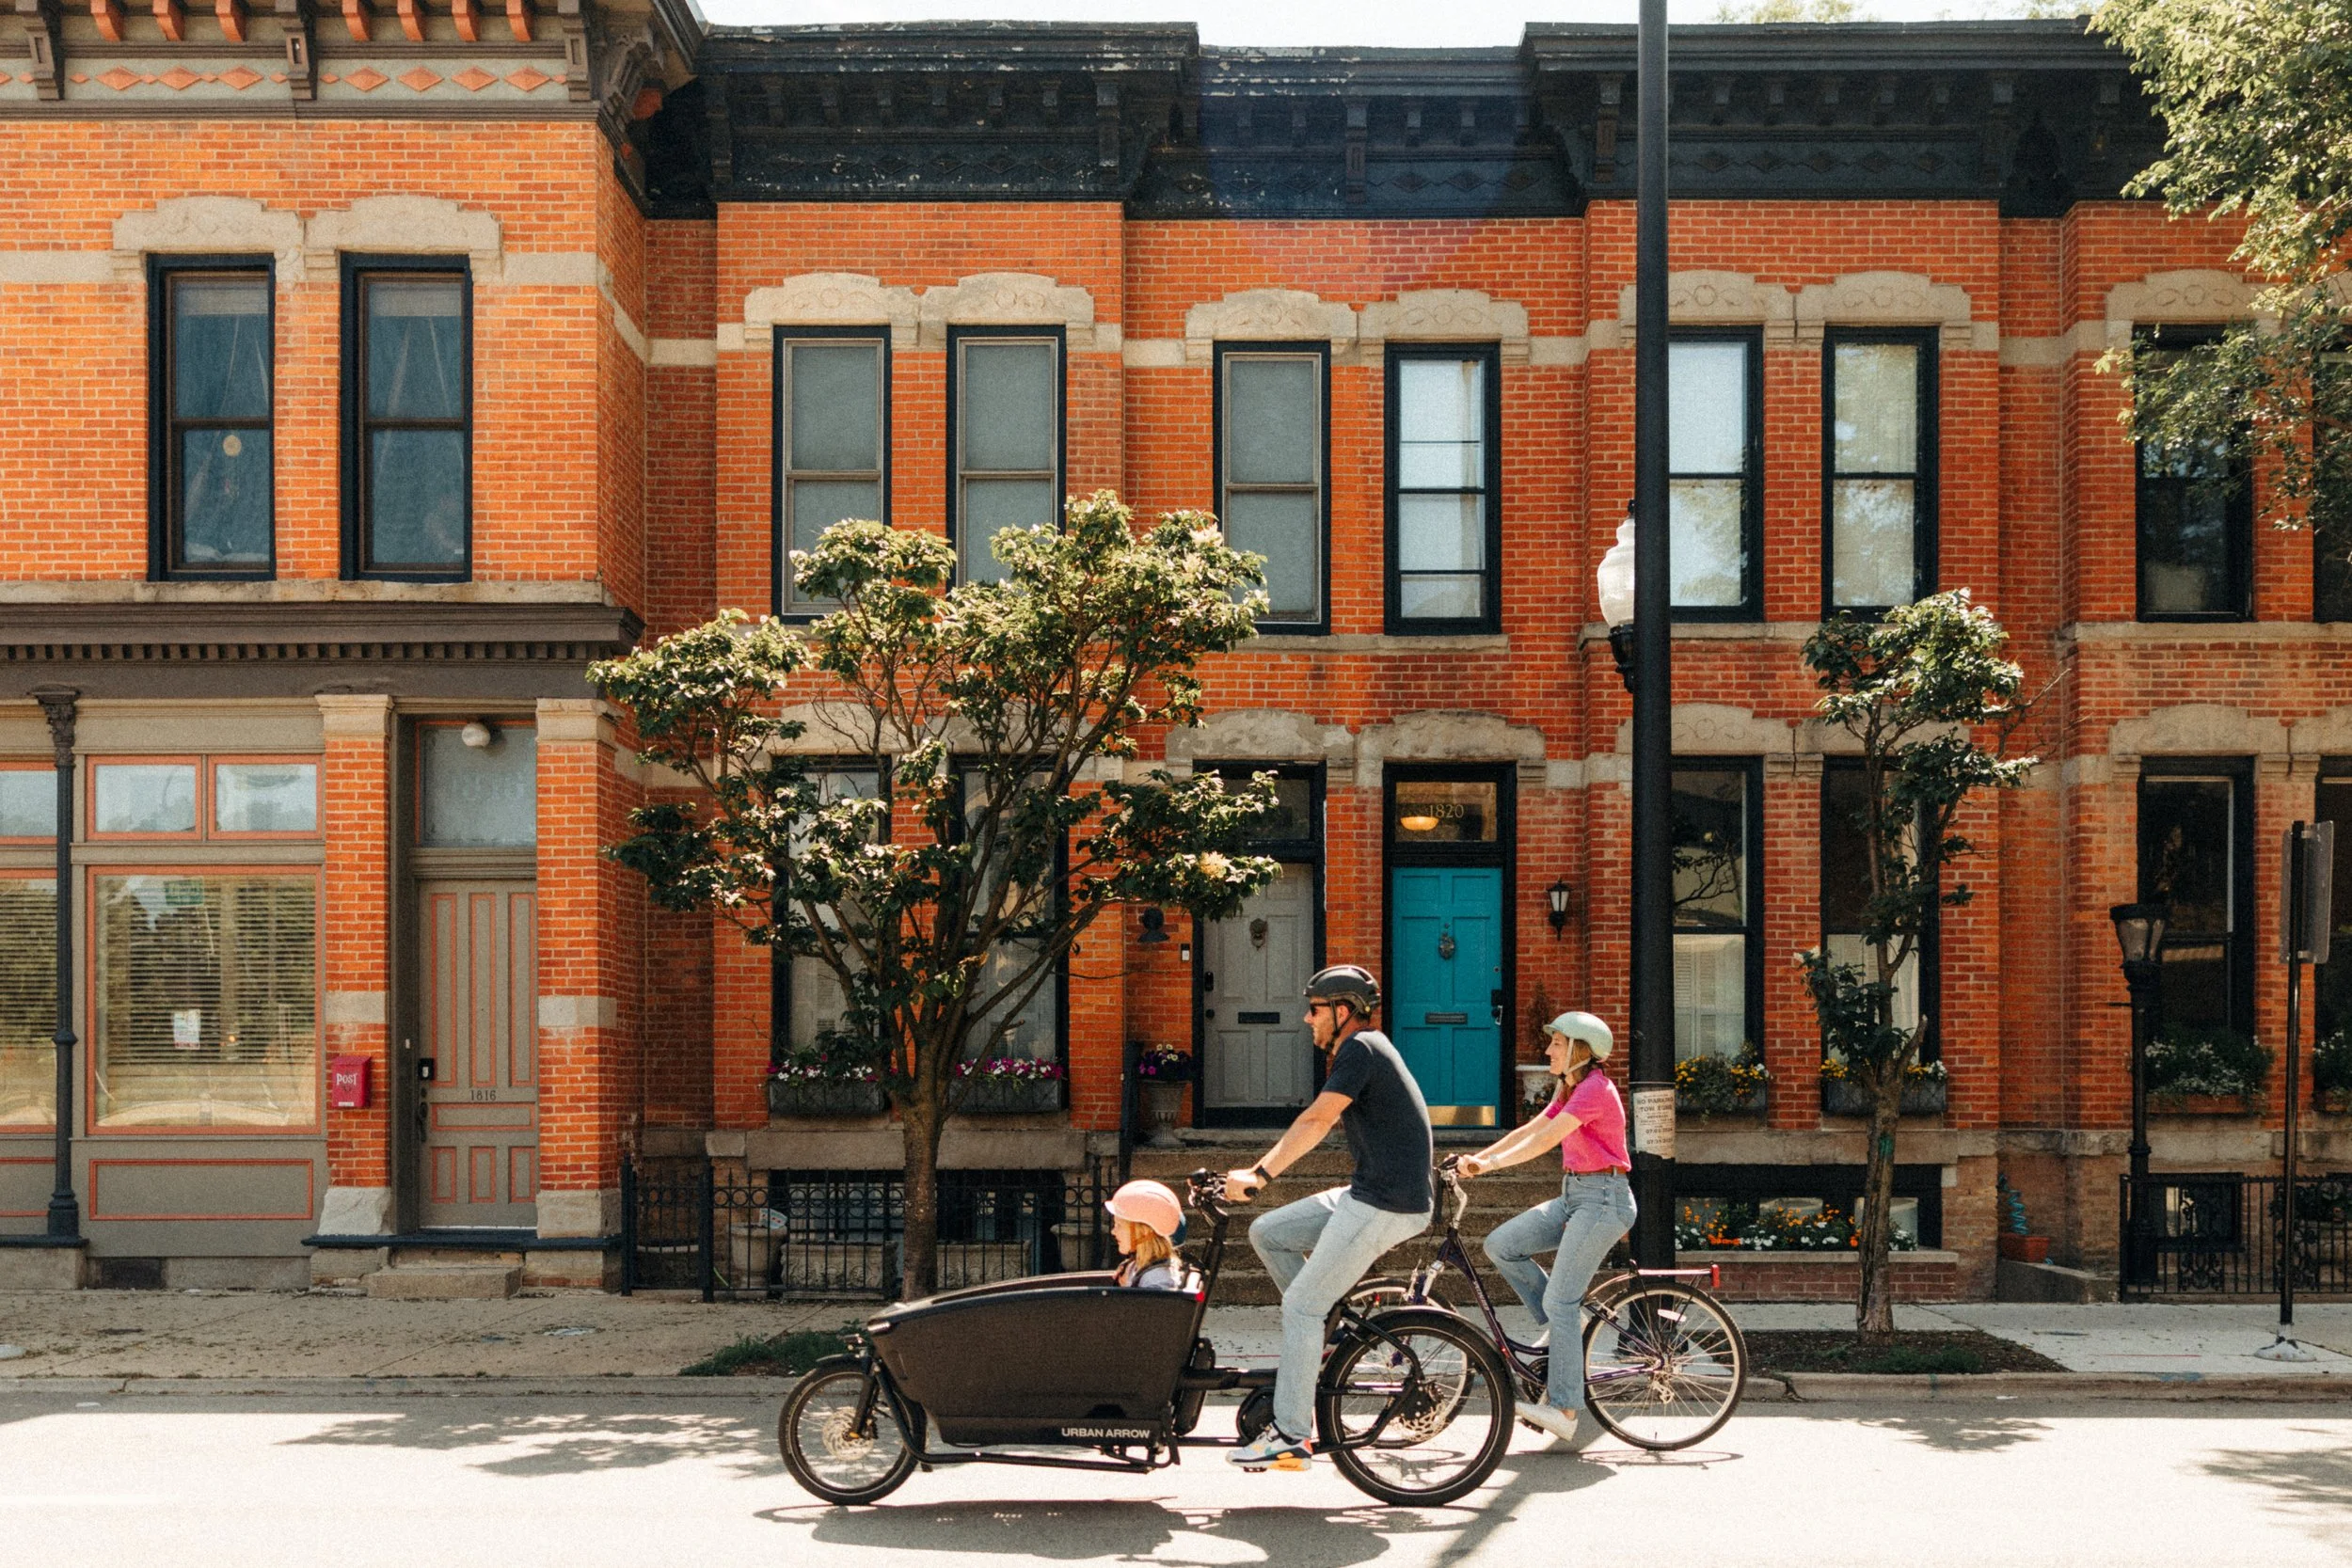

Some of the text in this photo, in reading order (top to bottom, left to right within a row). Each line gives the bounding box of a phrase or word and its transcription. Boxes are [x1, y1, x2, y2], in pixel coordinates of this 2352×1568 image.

[1429, 803, 1465, 818] 1820
[336, 1072, 358, 1085] POST
[470, 1089, 497, 1101] 1816
[1061, 1428, 1150, 1438] URBAN ARROW
